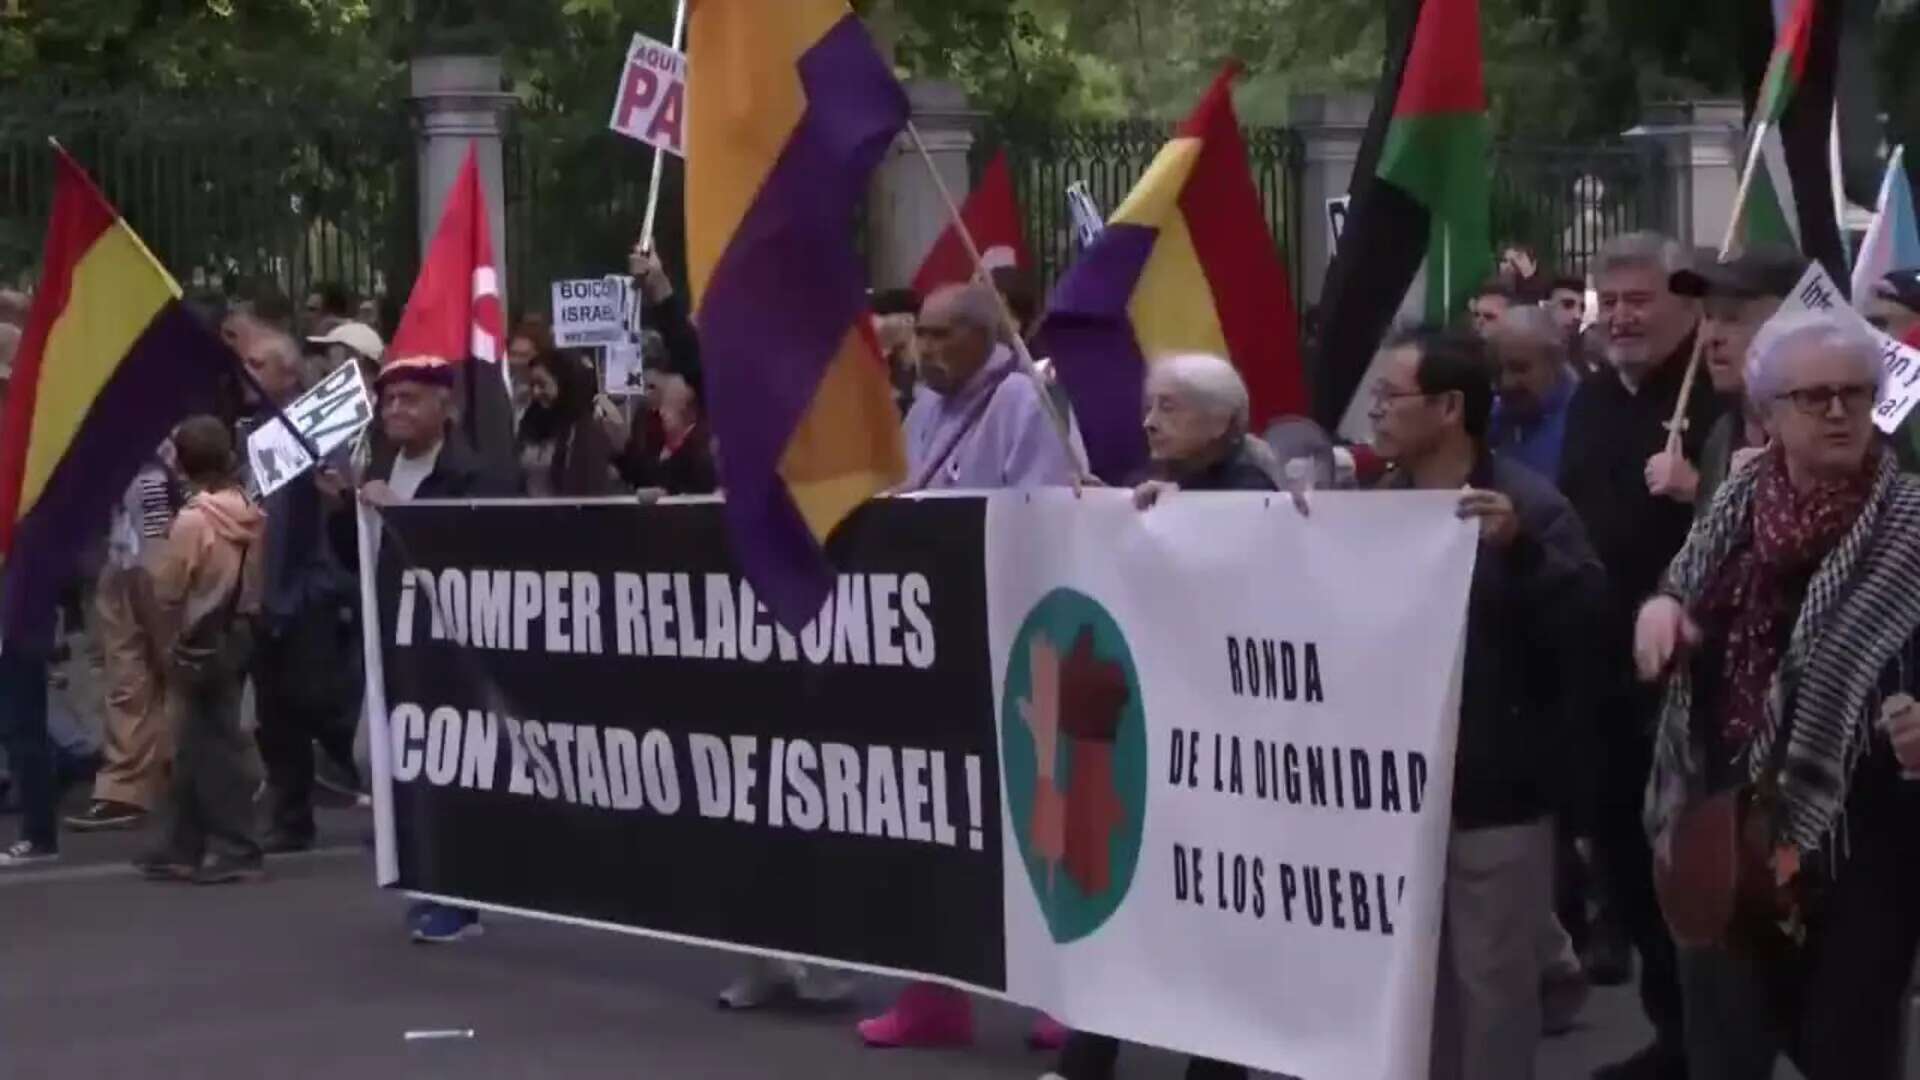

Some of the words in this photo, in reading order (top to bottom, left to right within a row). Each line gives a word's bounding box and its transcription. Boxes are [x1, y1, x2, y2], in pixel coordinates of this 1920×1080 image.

[632, 46, 678, 74] AQUI
[616, 64, 684, 146] PA
[294, 363, 369, 456] PAZ
[1227, 635, 1324, 703] RONDA
[390, 702, 498, 790] CON
[505, 716, 681, 815] ESTADO
[688, 732, 757, 824] DE
[768, 737, 956, 846] ISRAEL
[1169, 728, 1200, 788] DE
[1214, 733, 1243, 795] LA
[1254, 738, 1428, 814] DIGNIDAD
[1174, 842, 1205, 906] DE
[1217, 851, 1265, 919] LOS
[1279, 861, 1405, 936] PUEBL
